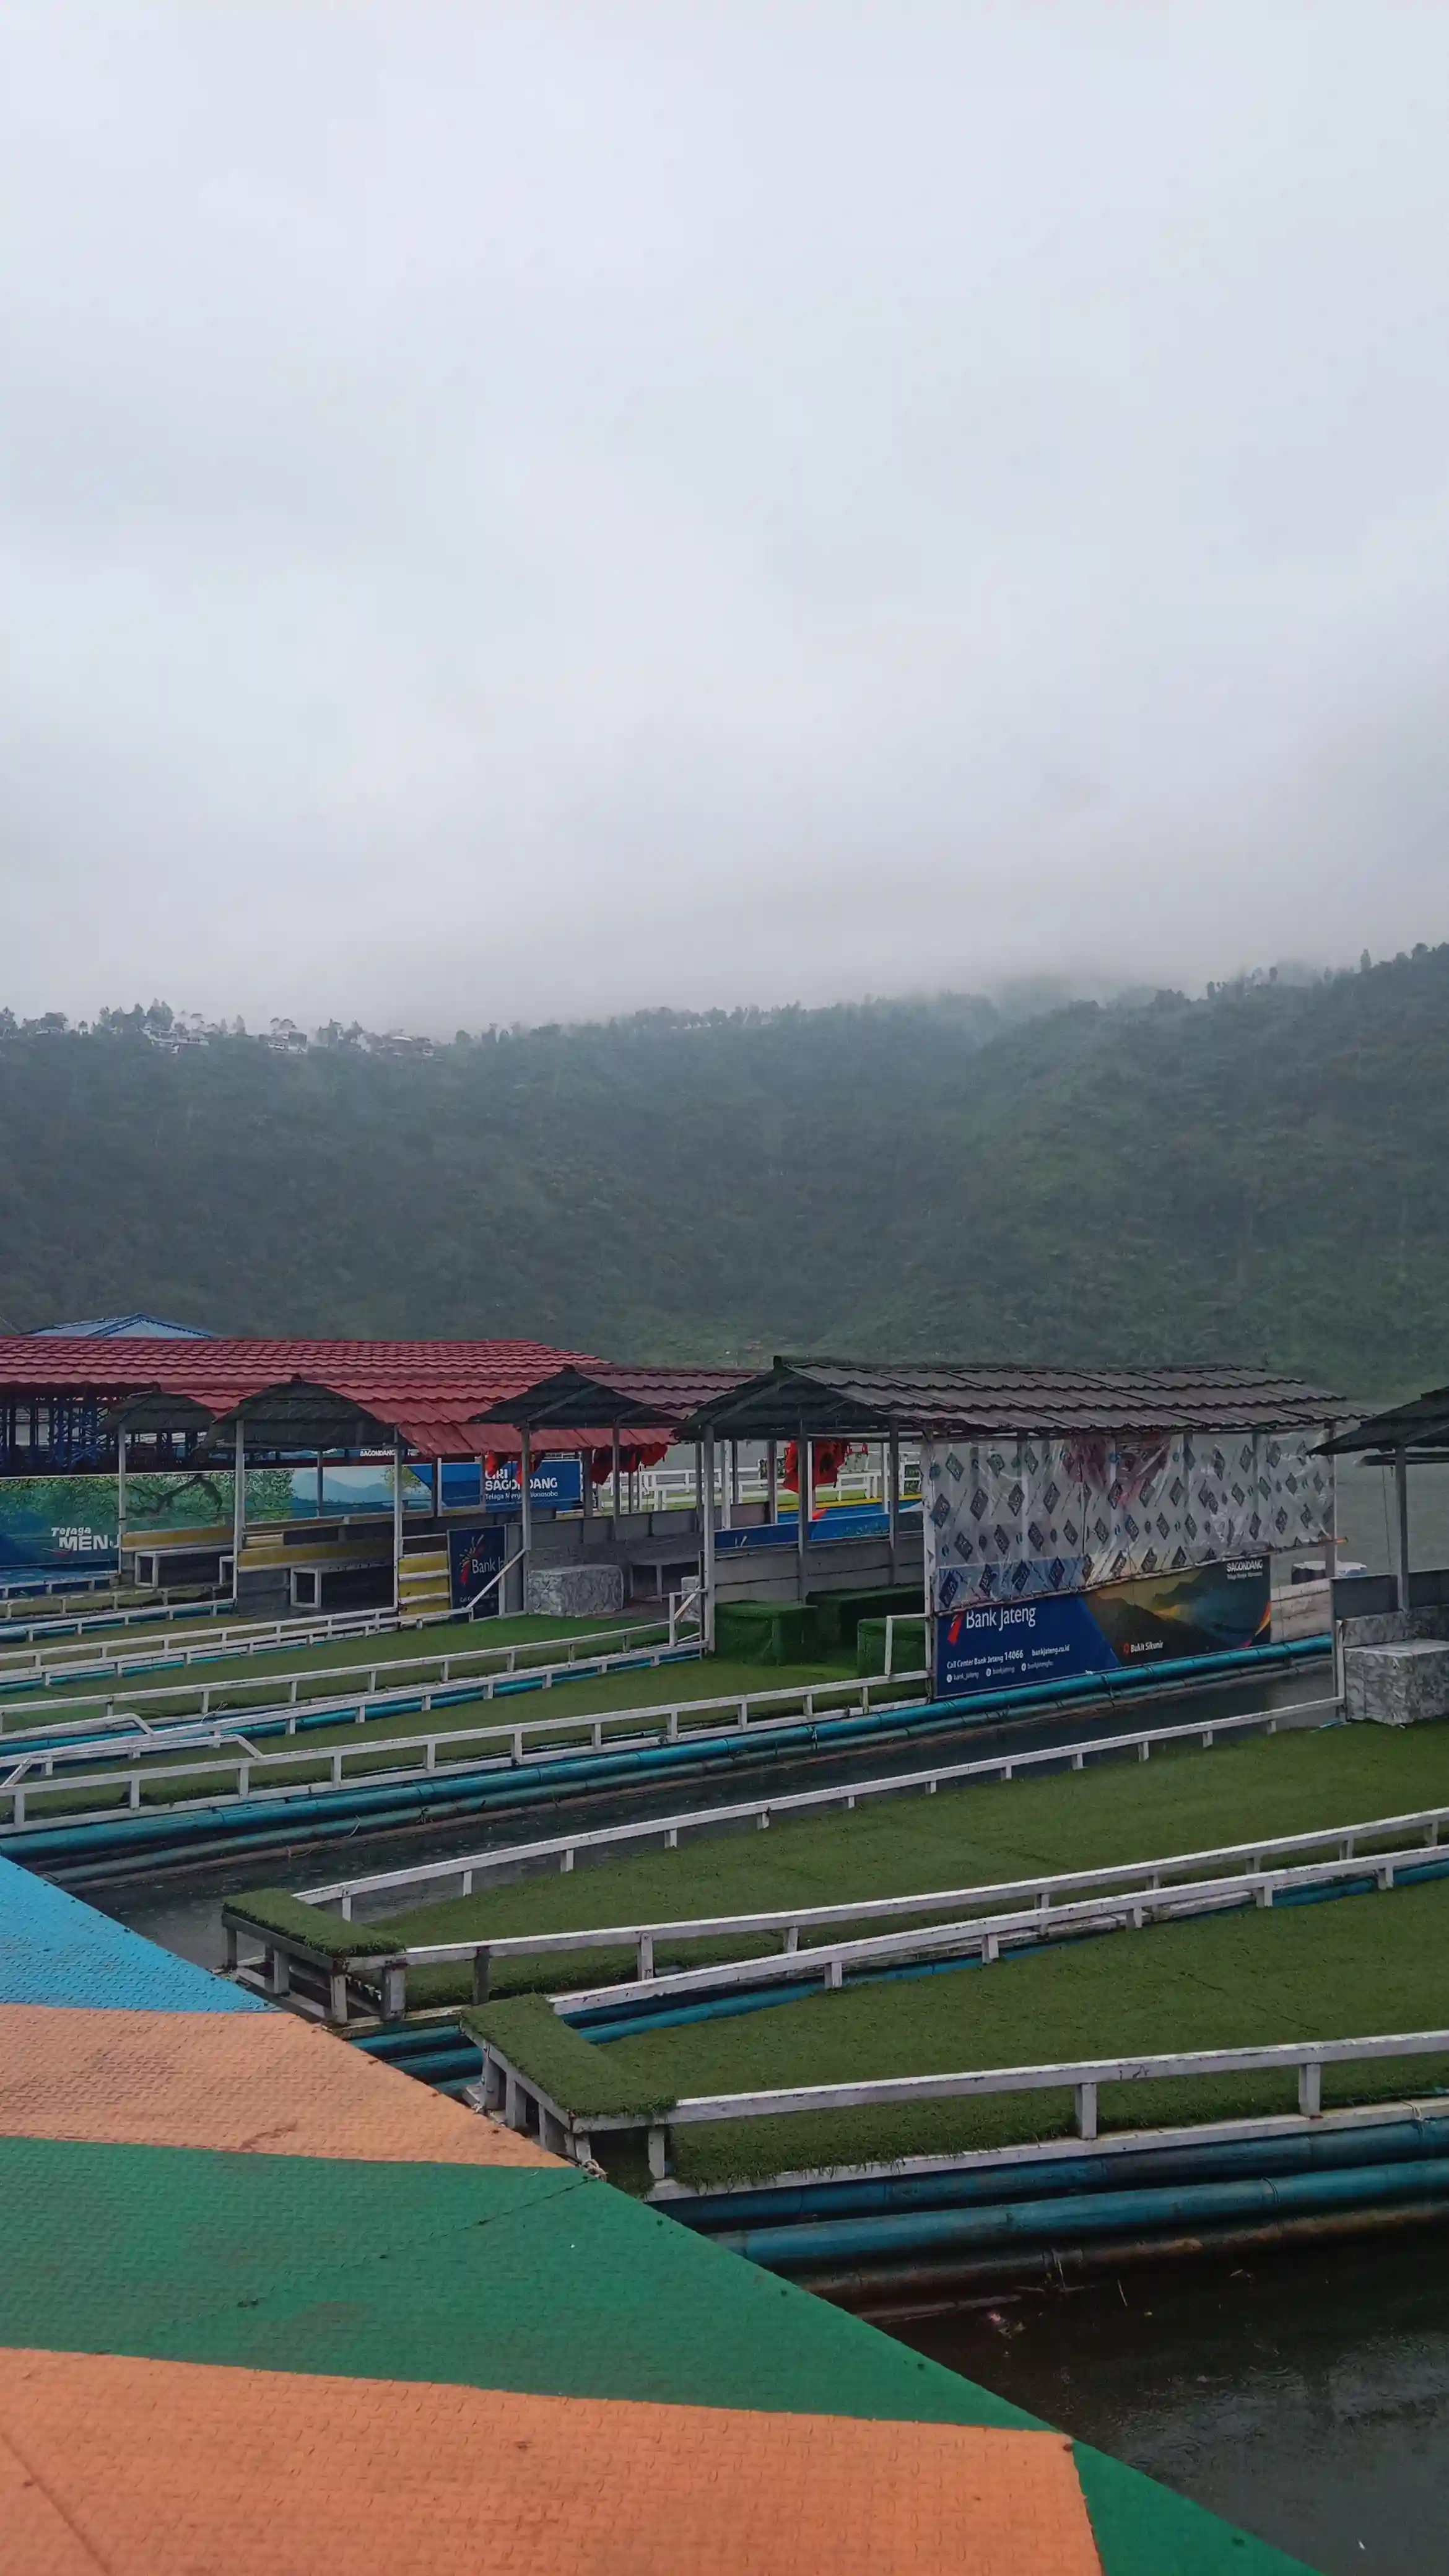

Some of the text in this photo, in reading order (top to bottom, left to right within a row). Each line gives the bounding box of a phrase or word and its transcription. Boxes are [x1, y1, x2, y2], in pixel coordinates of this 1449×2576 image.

[51, 1526, 91, 1537] Telaga
[471, 1557, 496, 1573] Bank
[1227, 1559, 1263, 1572] SAGONDANG
[966, 1607, 1037, 1632] Bank Jateng
[947, 1661, 956, 1669] Call
[957, 1658, 974, 1668] Center
[974, 1656, 986, 1665] Bank
[987, 1655, 1004, 1664] Jateng
[1004, 1649, 1024, 1661] 14066
